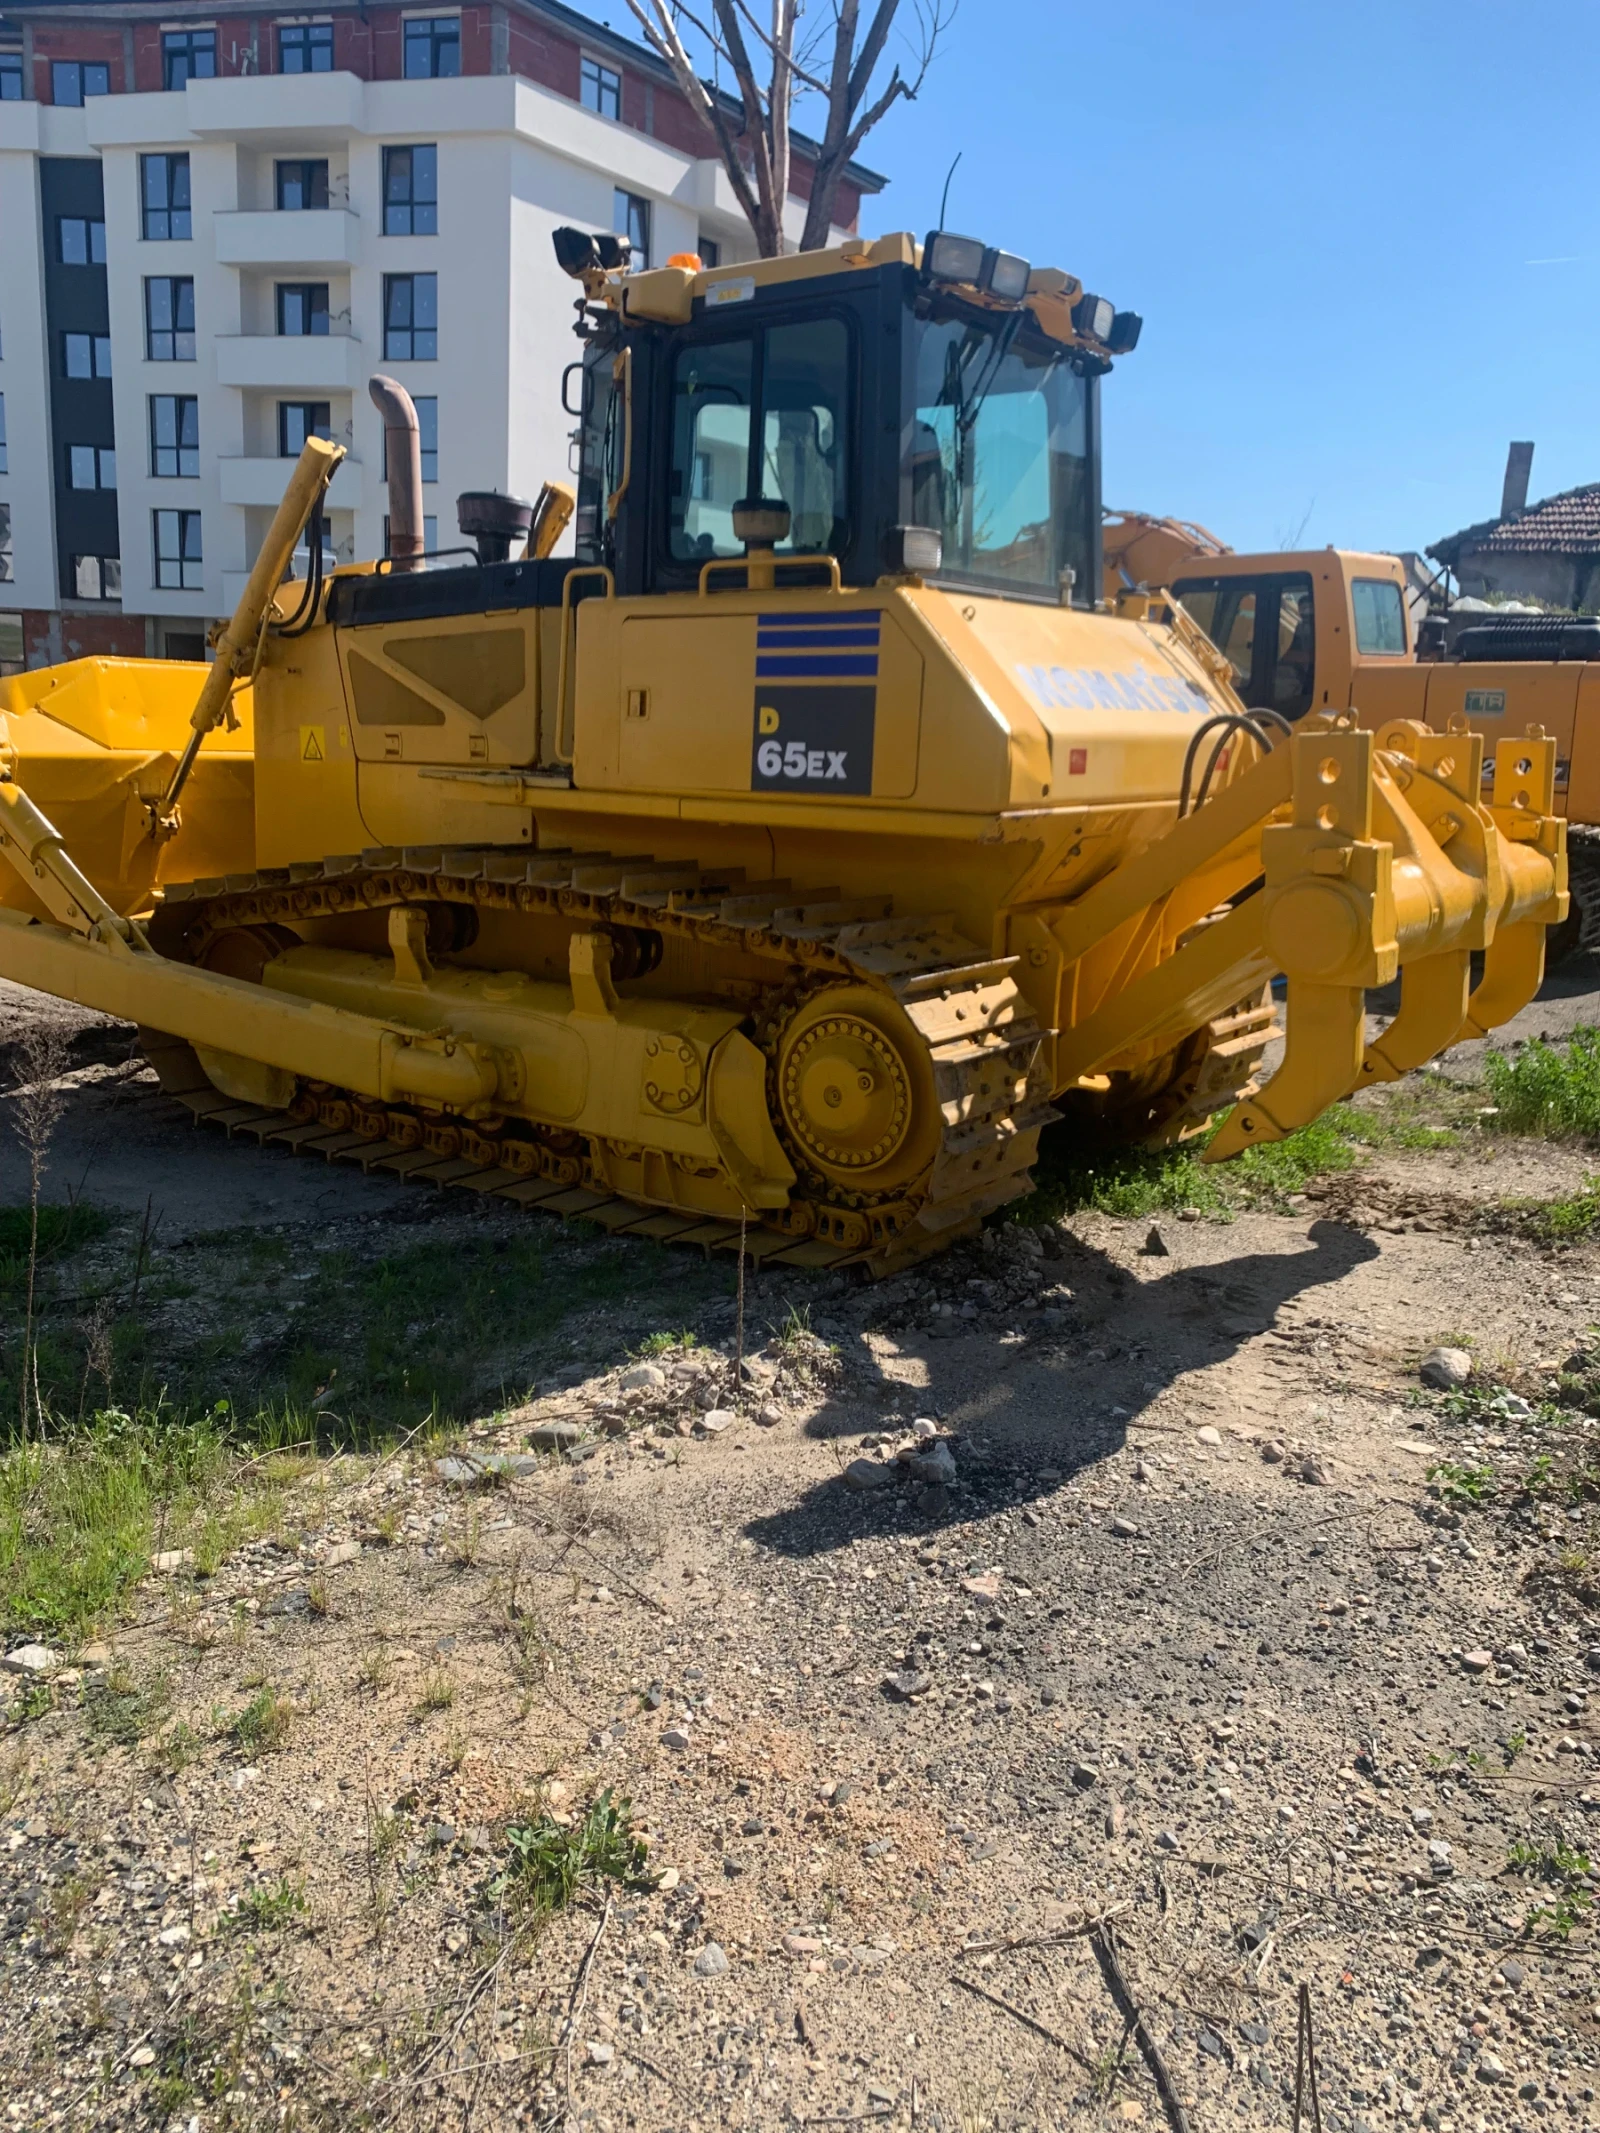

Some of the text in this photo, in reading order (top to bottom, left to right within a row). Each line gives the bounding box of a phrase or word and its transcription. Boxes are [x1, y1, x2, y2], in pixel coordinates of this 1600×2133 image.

[1015, 663, 1209, 714] KOMATSU
[758, 706, 780, 734] D
[757, 740, 848, 779] 65EX
